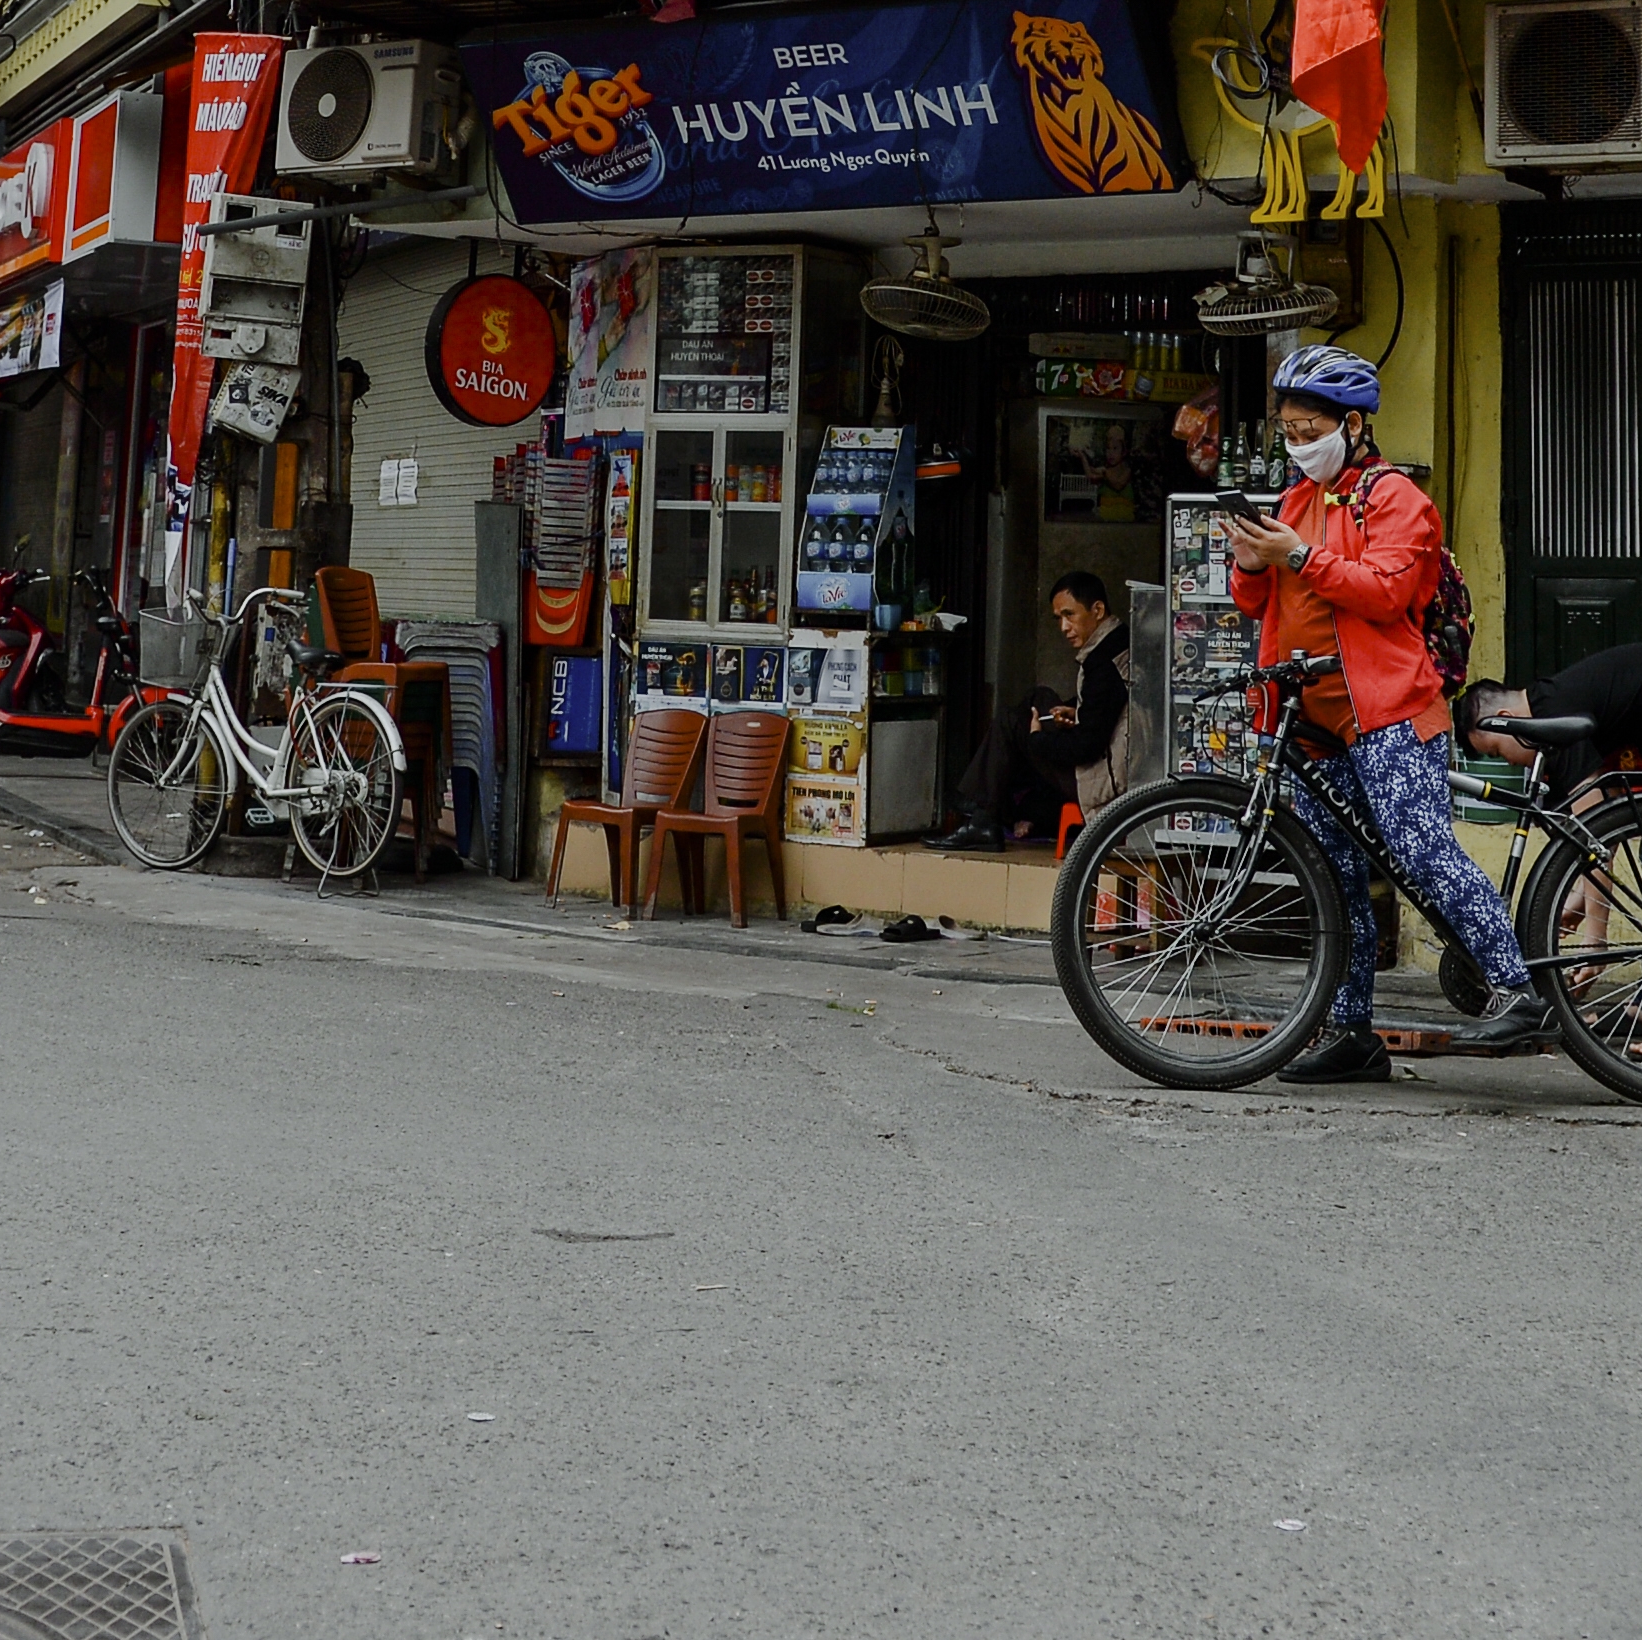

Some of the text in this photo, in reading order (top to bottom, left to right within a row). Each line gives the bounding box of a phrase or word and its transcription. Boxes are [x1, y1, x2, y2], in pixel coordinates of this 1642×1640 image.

[373, 46, 415, 60] SAMSUNG
[772, 43, 849, 69] BEER
[492, 62, 654, 158] Tiger
[671, 81, 999, 144] HUYỀN LINH
[538, 142, 575, 163] SINCE
[757, 155, 778, 171] 41
[831, 150, 873, 173] Ngọc
[590, 152, 653, 185] LAGER BEER
[482, 359, 505, 376] BIA
[258, 385, 289, 408] SIKA
[454, 368, 528, 401] SAIGON
[550, 660, 568, 715] NCB
